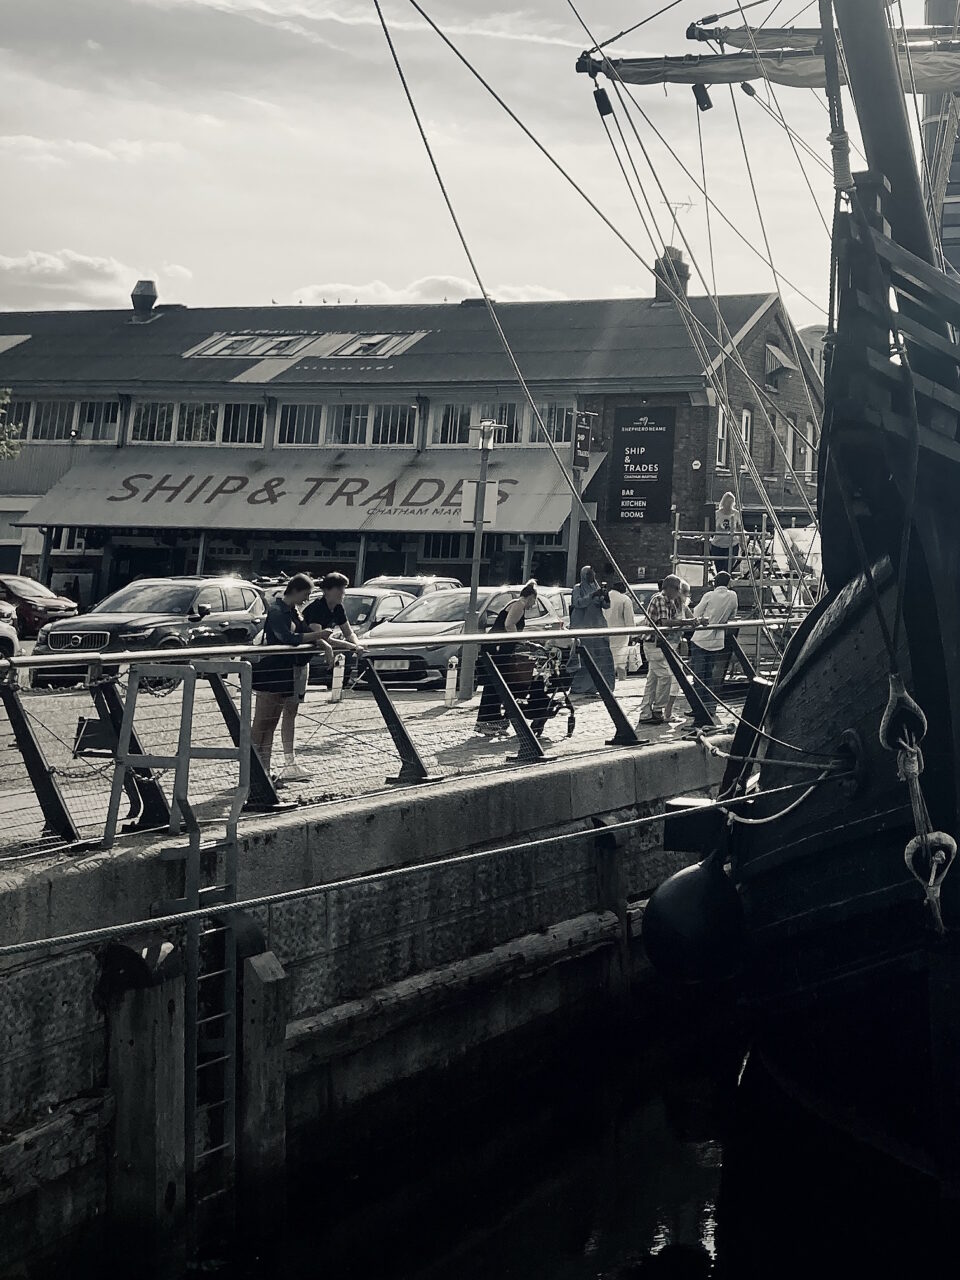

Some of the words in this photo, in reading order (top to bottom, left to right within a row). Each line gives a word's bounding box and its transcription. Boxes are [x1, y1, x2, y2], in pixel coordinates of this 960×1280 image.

[624, 447, 646, 455] SHIP
[624, 455, 631, 463] &
[623, 464, 659, 472] TRADES
[106, 474, 249, 504] SHIP
[247, 477, 286, 505] &
[367, 507, 429, 516] CHATHAM
